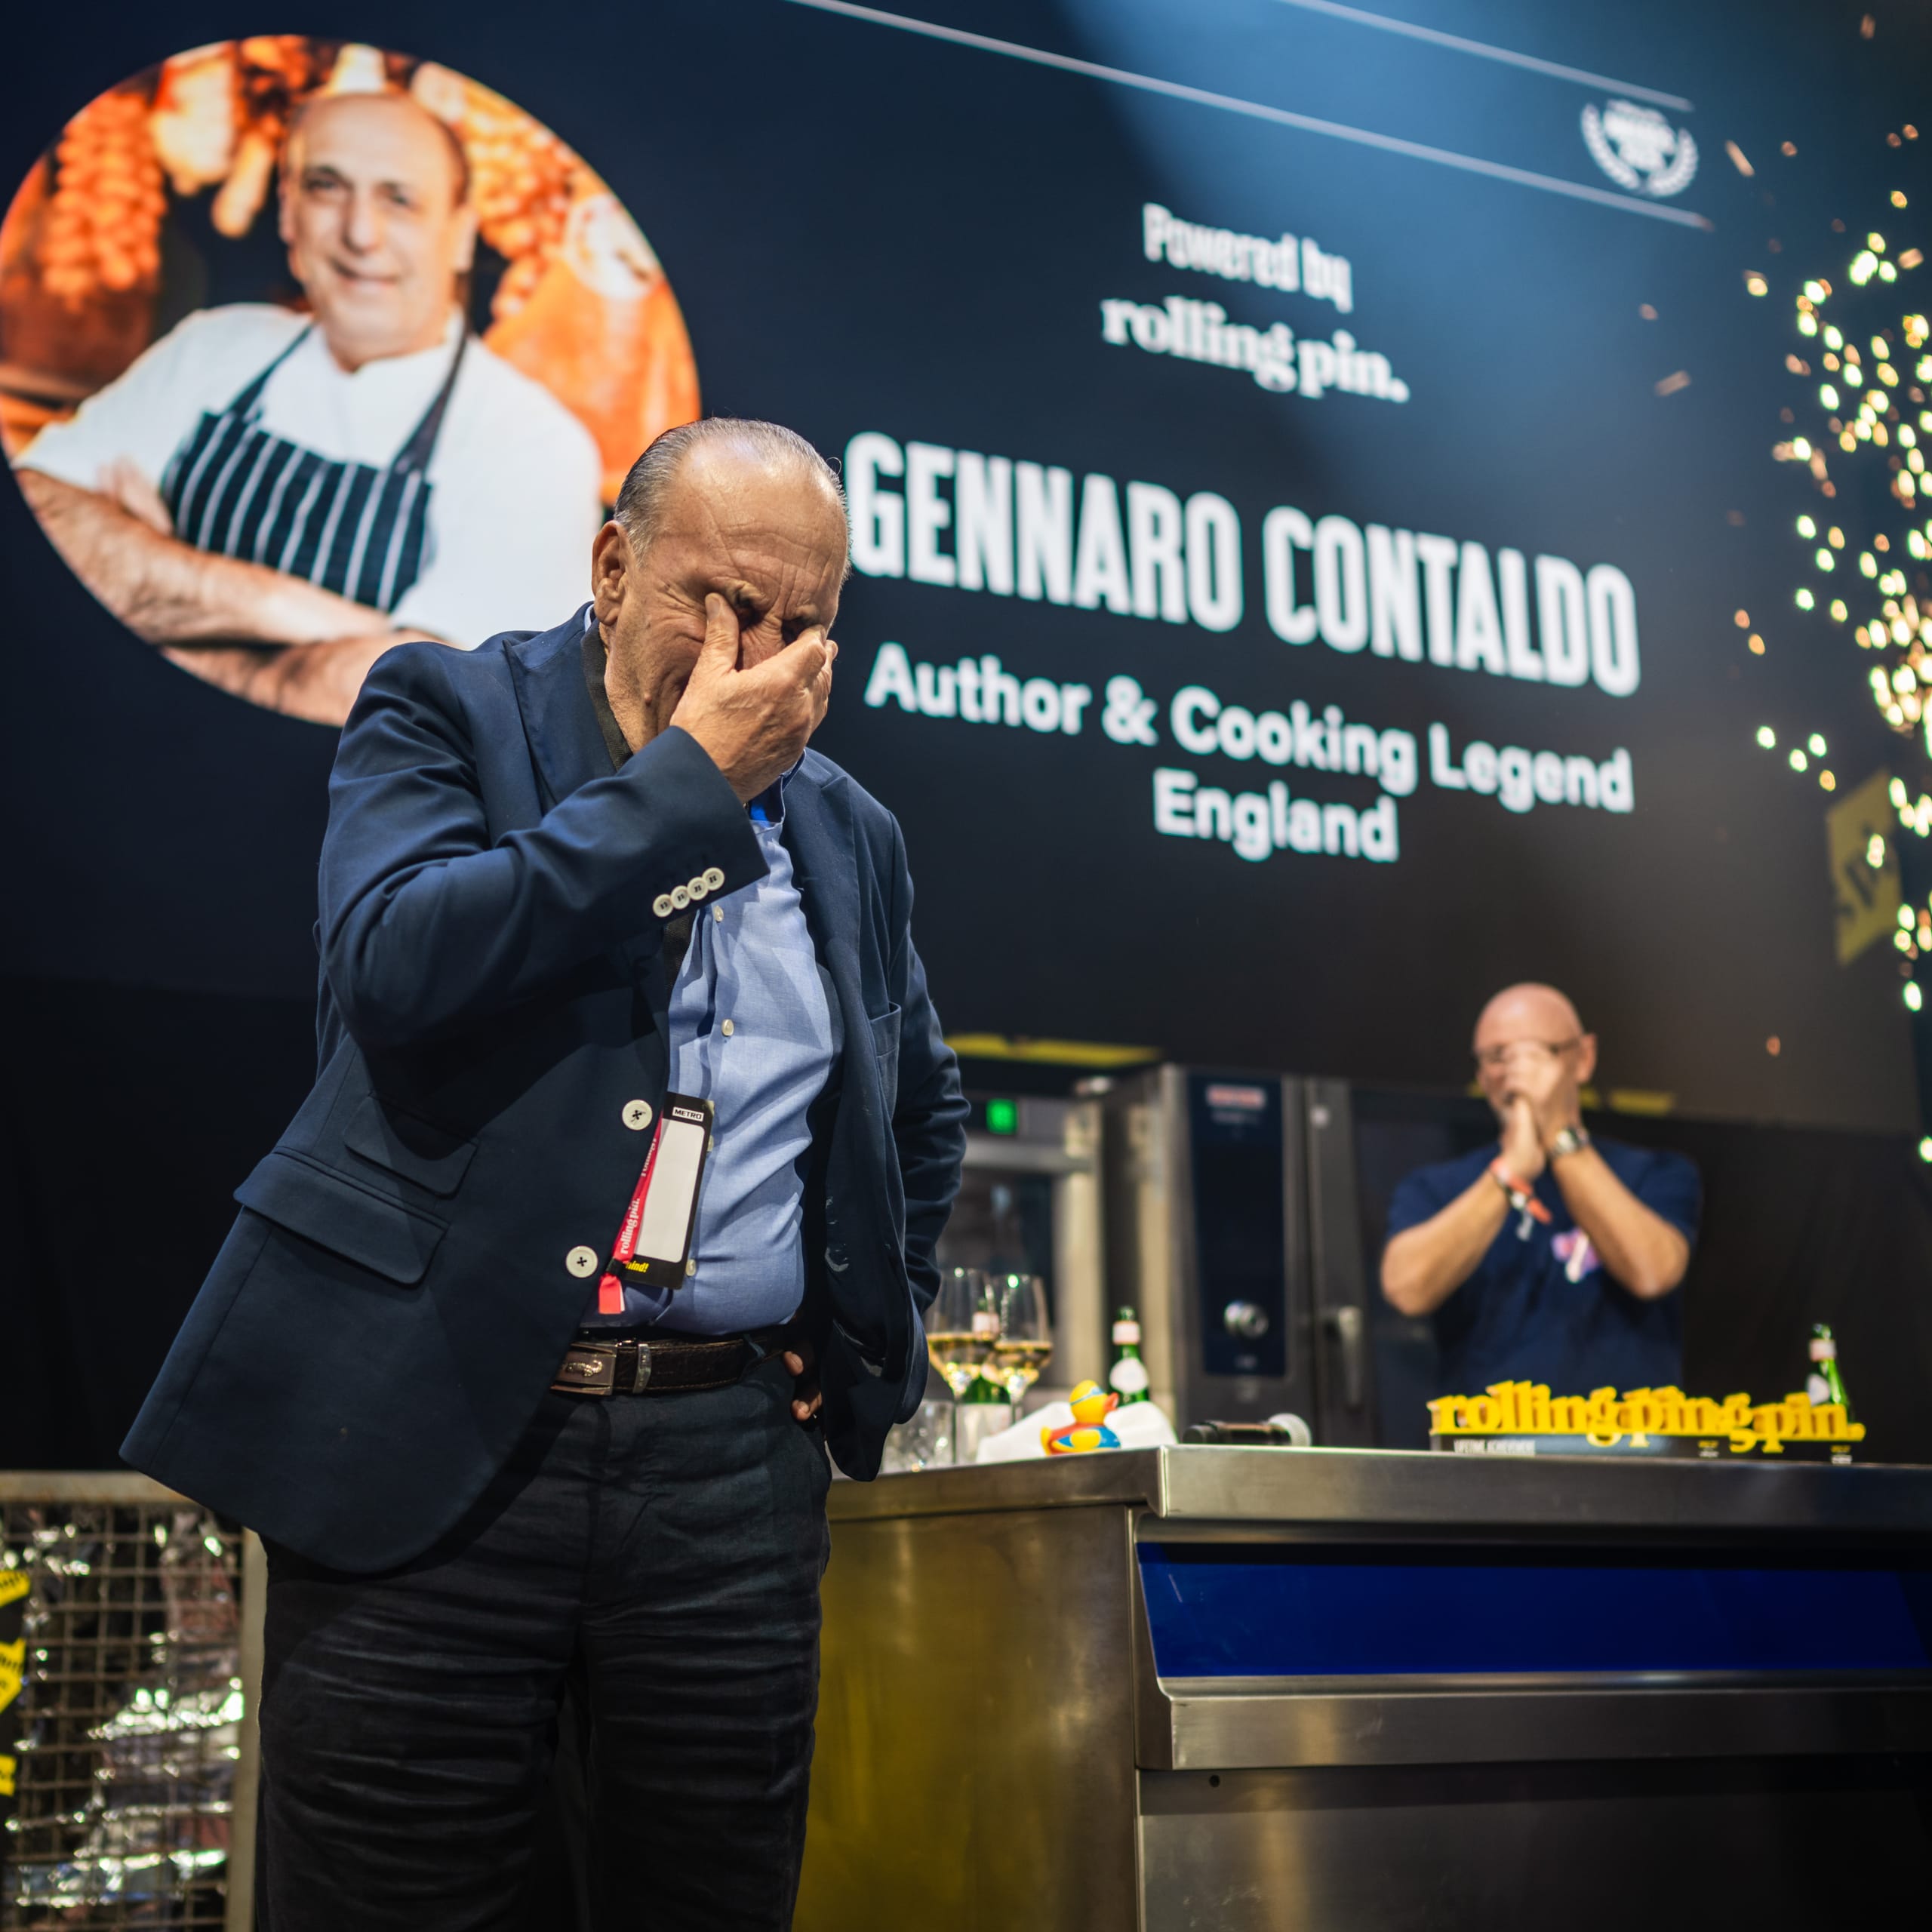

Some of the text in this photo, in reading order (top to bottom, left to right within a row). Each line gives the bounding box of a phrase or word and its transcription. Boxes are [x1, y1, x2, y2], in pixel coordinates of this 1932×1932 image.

[1143, 202, 1355, 314] Powered by
[1100, 295, 1411, 404] rolling pin.
[844, 431, 1641, 697] GENNARO CONTALDO
[865, 642, 1635, 814] Author & Cooking Legend
[1152, 767, 1401, 863] England
[675, 1109, 703, 1121] METRO
[1426, 1380, 1623, 1447] rolling
